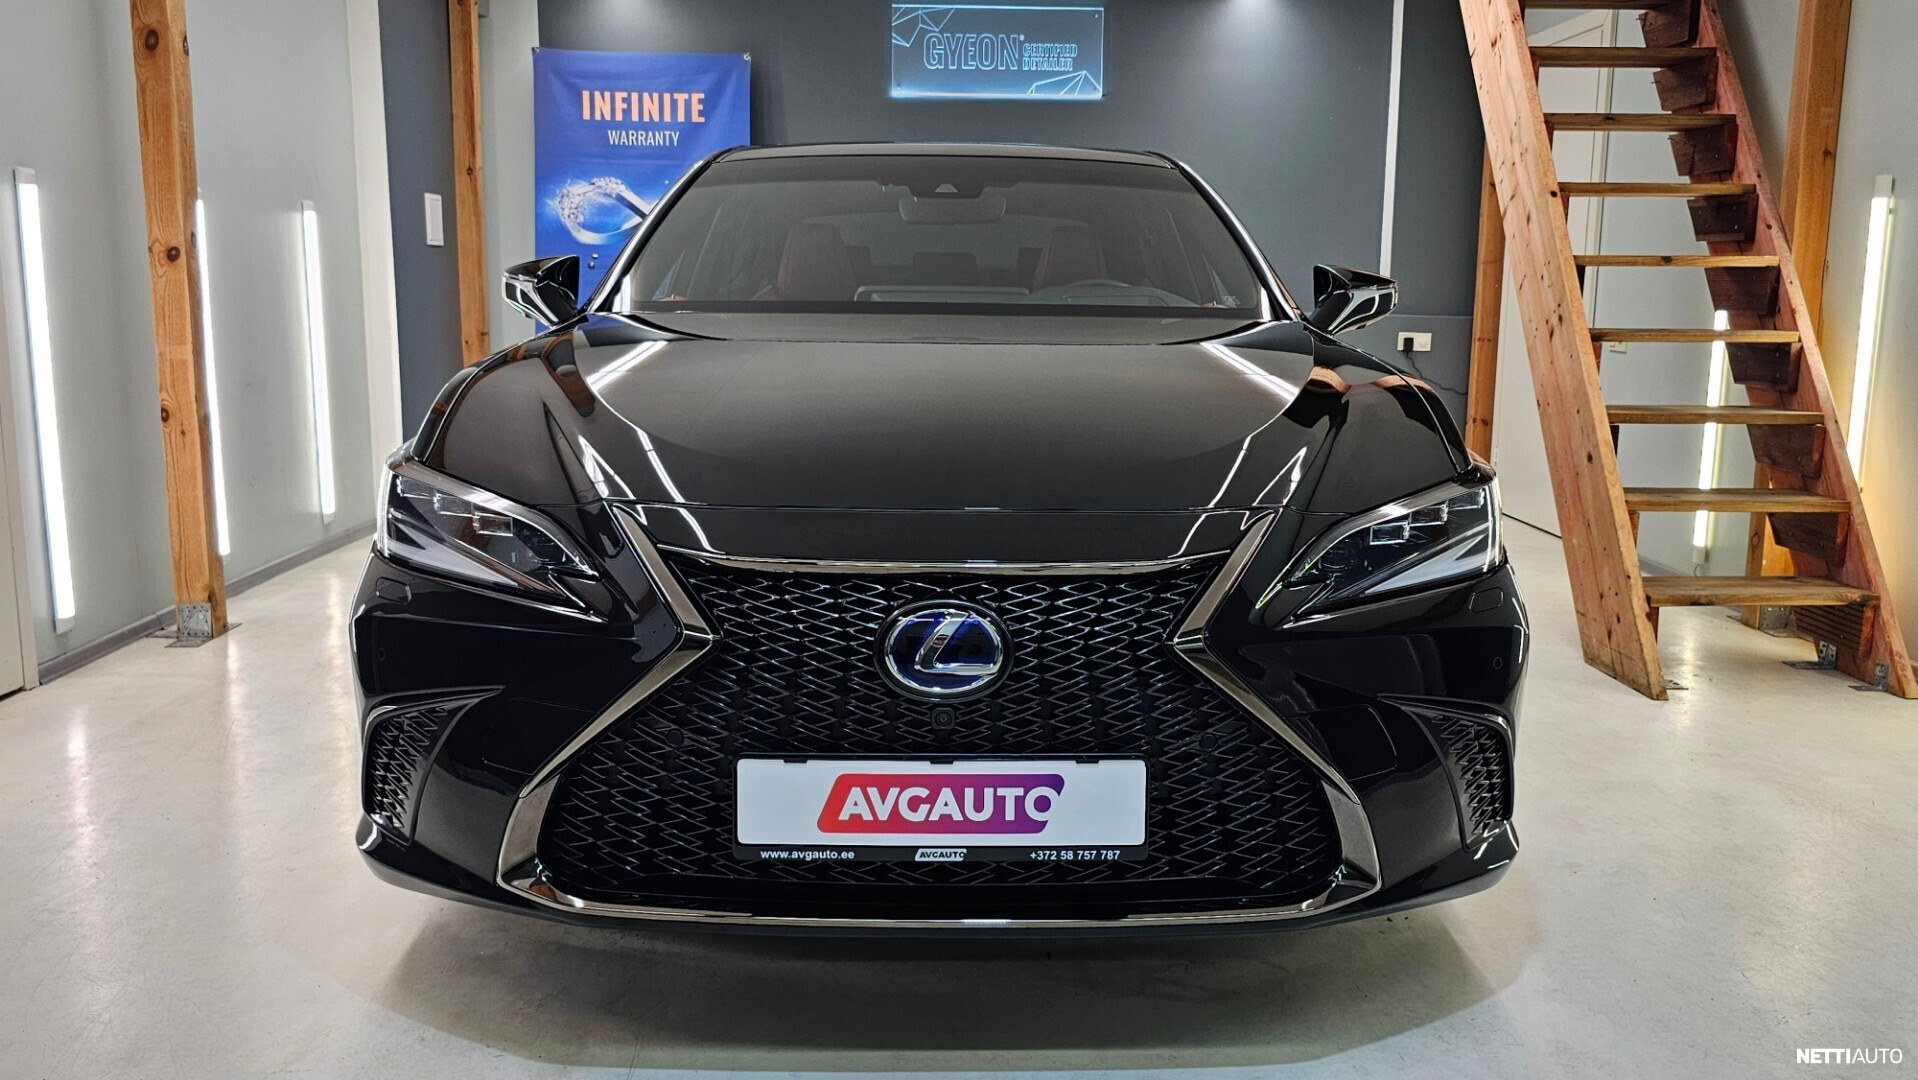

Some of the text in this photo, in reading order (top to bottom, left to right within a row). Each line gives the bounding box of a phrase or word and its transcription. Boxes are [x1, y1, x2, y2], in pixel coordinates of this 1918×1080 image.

[923, 33, 1019, 70] GYEON
[1022, 43, 1078, 58] CERTIFIED
[1022, 57, 1073, 71] DETAILER
[582, 90, 705, 123] INFINITE
[608, 129, 680, 147] WARRANTY
[838, 786, 1060, 822] AVGAUTO
[760, 849, 855, 861] www.avgauto.ee
[919, 851, 966, 859] AVGAUTO
[1030, 850, 1120, 860] +372 58 757 787
